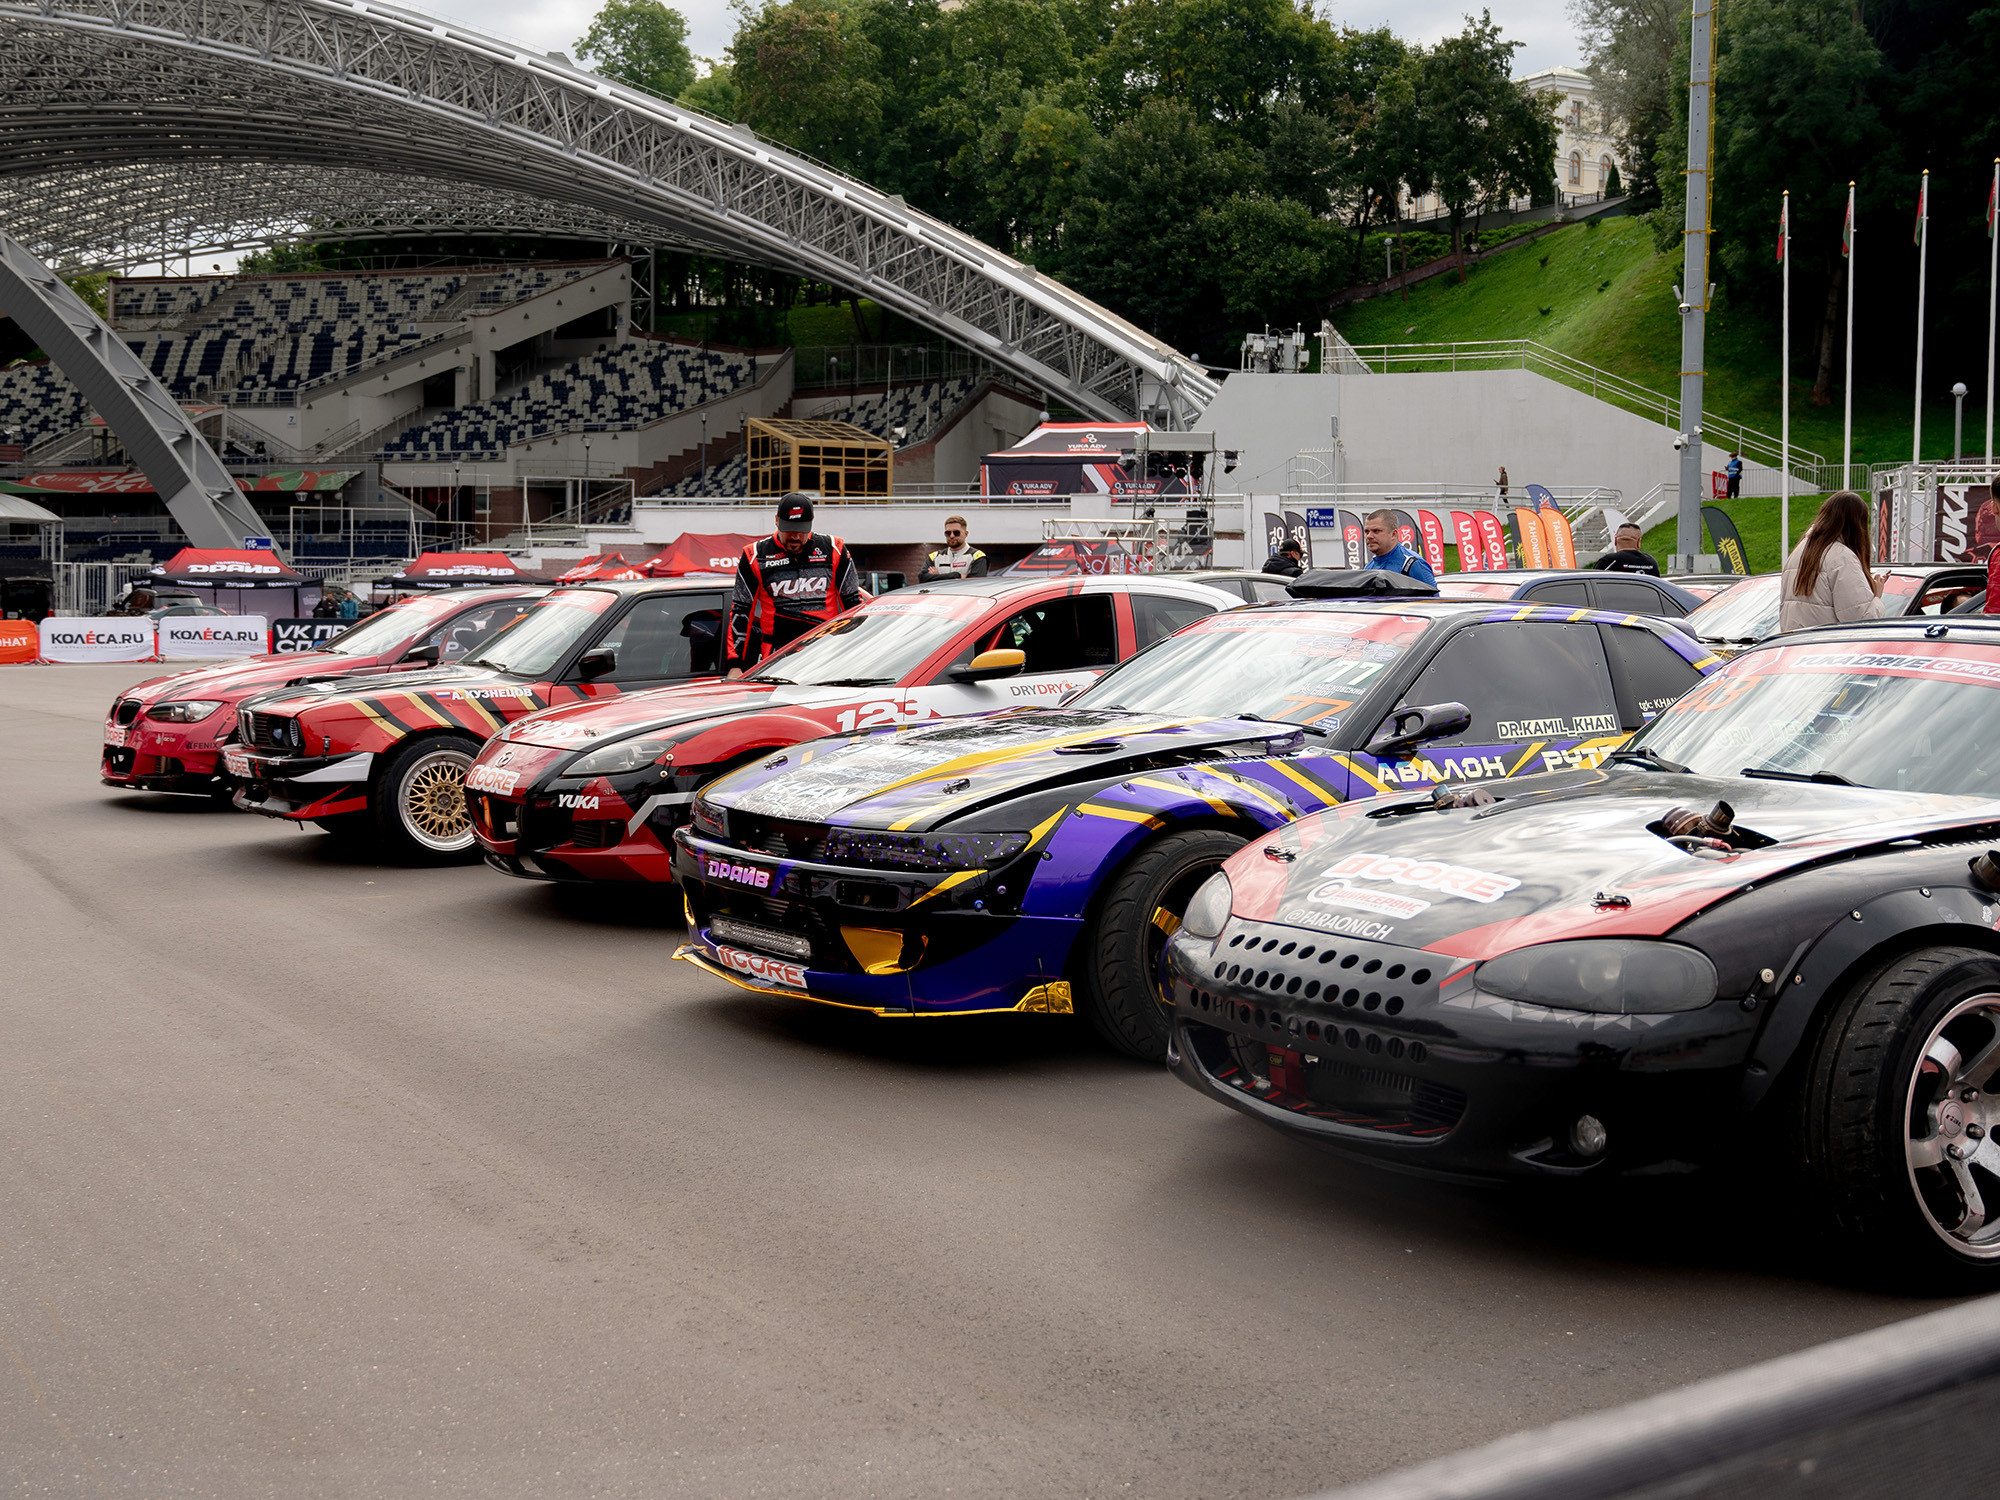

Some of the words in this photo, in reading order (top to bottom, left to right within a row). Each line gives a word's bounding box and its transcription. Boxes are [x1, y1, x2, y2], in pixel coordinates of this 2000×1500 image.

[766, 558, 790, 568] FORTIS
[770, 577, 828, 597] YUKA
[276, 624, 312, 639] VK
[194, 742, 218, 750] FENIX
[1378, 756, 1506, 784] АВАЛОН
[558, 794, 600, 810] YUKA
[1335, 888, 1422, 912] ШИНСЕРВИС
[1284, 910, 1394, 940] @FARAONICH
